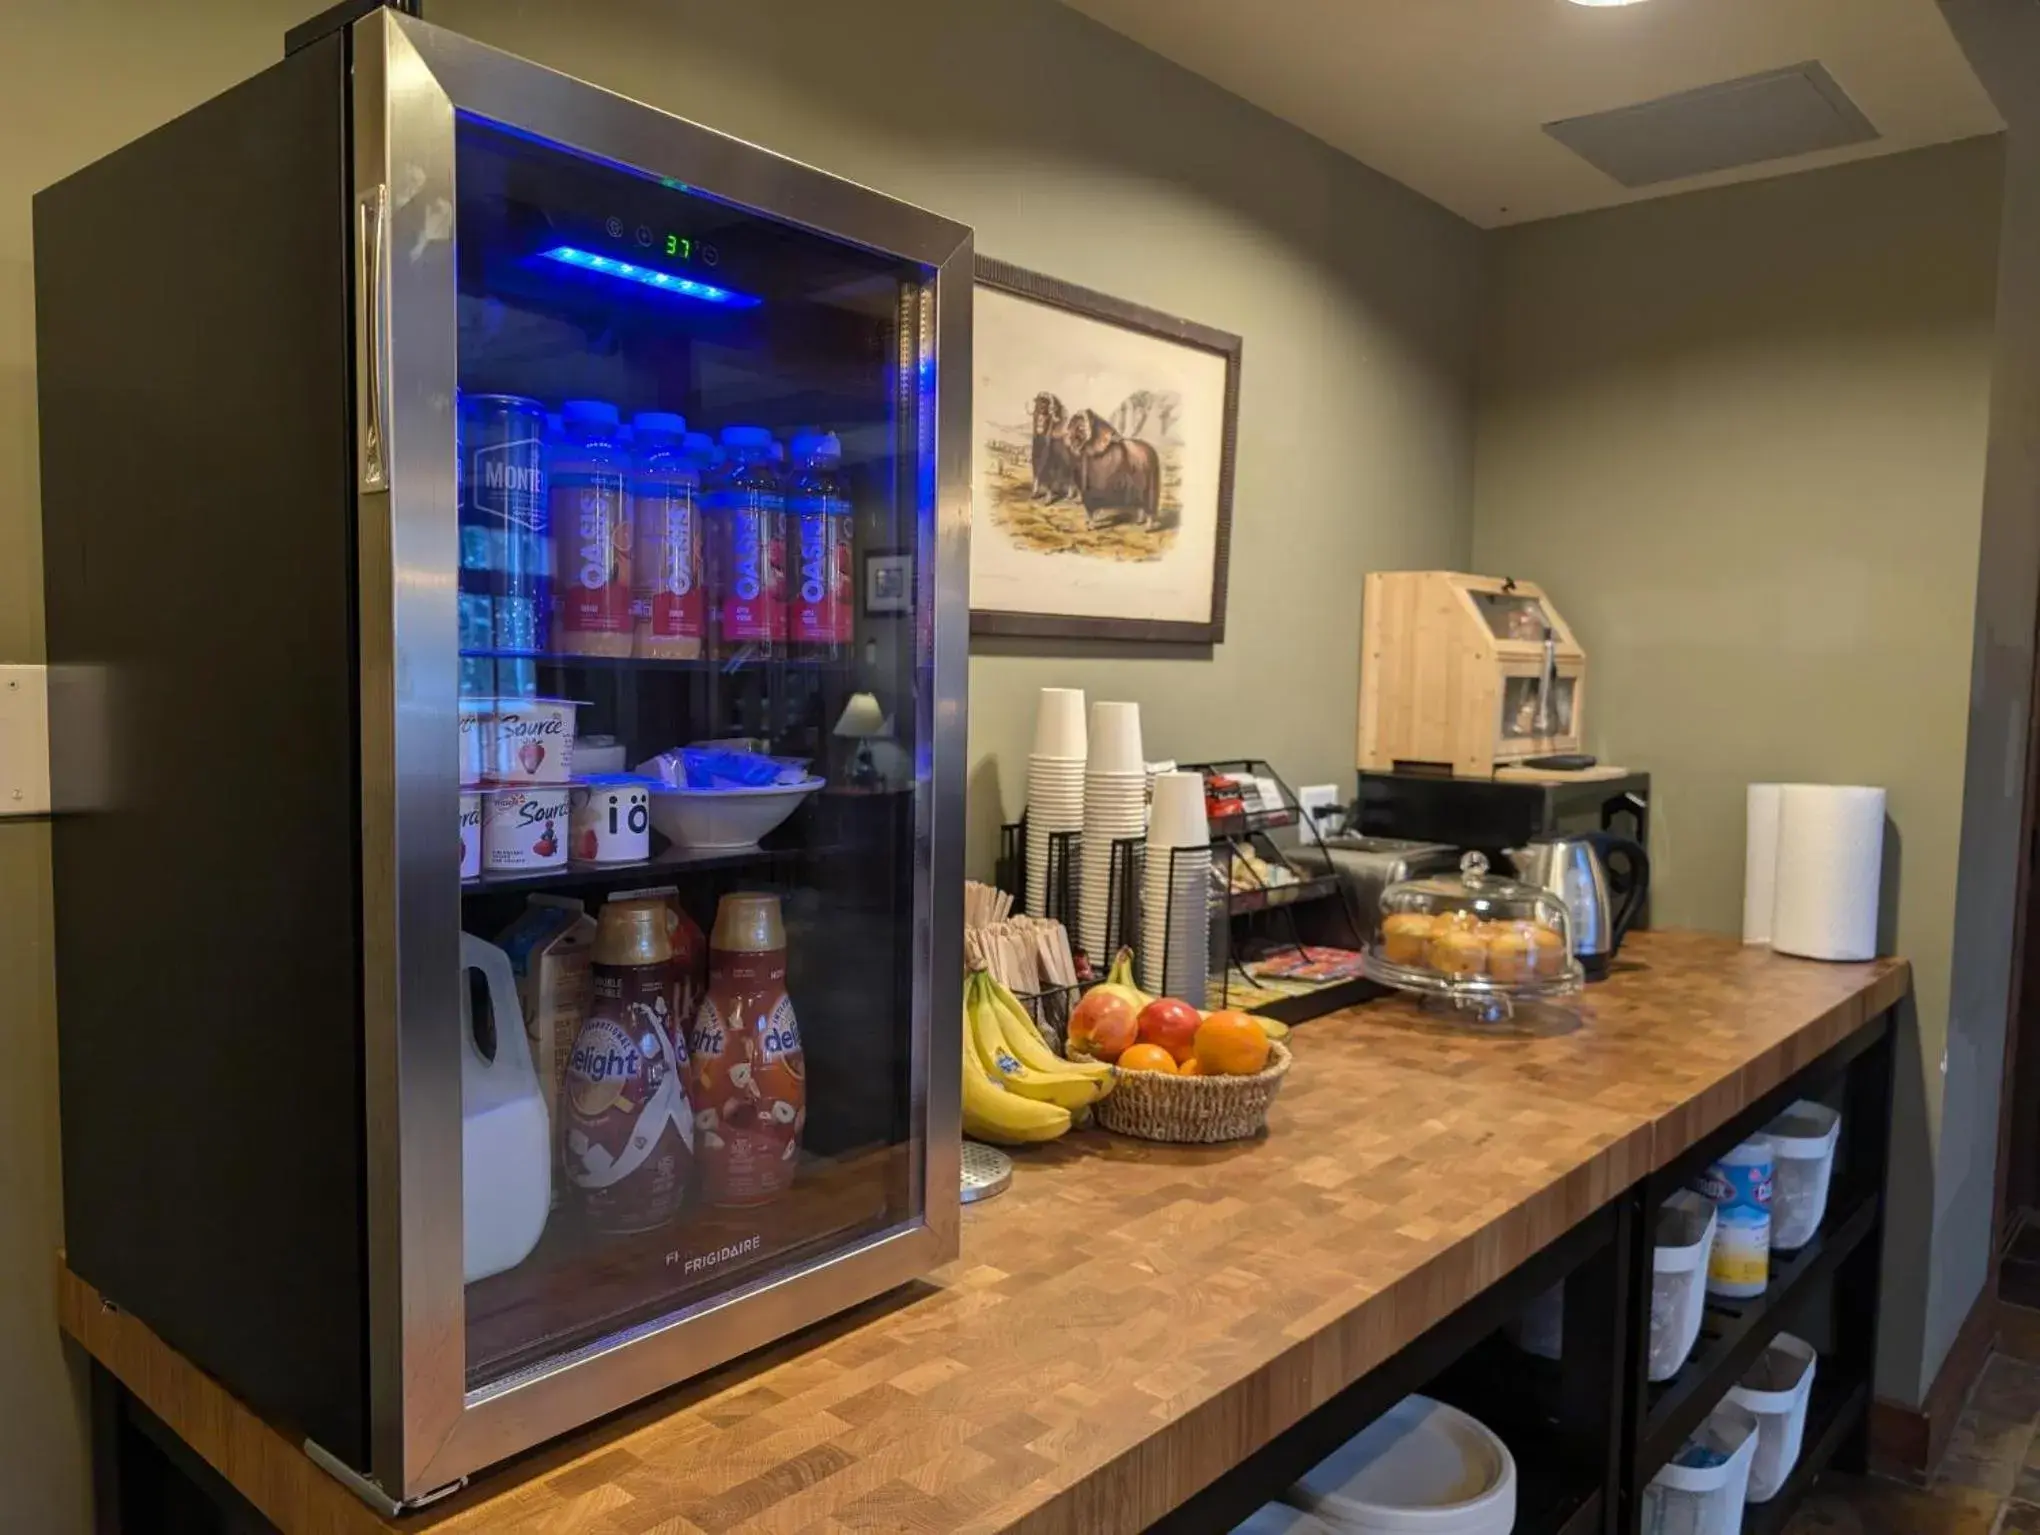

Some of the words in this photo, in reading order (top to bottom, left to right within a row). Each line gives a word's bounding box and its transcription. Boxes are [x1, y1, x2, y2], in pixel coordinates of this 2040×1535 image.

[665, 234, 690, 259] 37
[497, 714, 563, 740] Source
[572, 1046, 639, 1082] elight
[684, 1234, 761, 1275] FRIGIDAIRE
